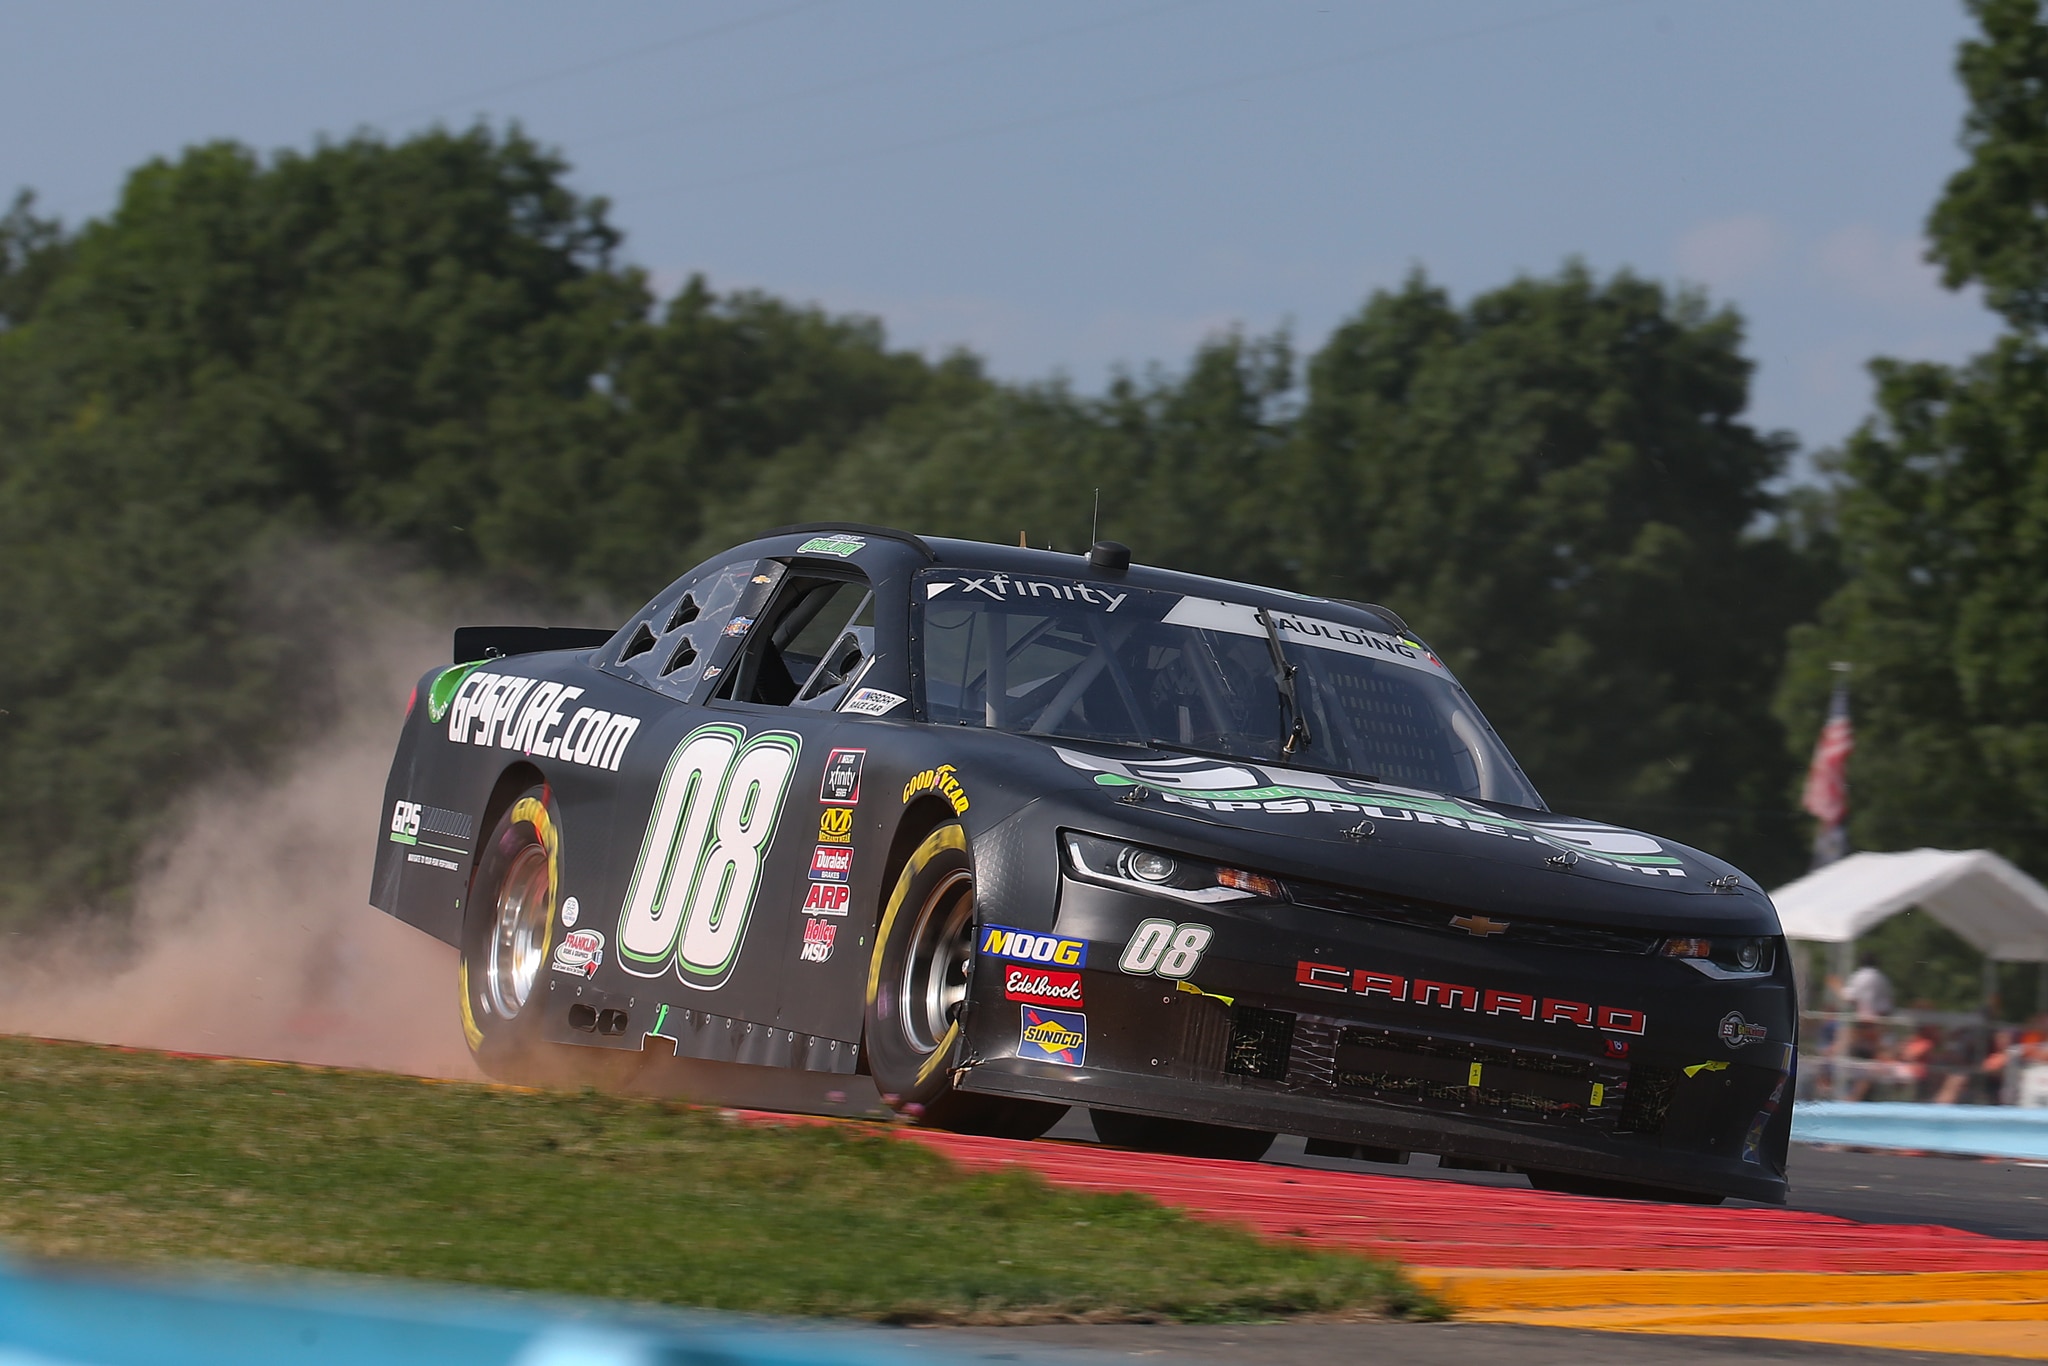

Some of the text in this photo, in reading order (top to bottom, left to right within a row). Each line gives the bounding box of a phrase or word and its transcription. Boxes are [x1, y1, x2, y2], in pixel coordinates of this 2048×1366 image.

[958, 574, 1127, 612] xfinity
[829, 765, 856, 792] xfinity
[903, 768, 970, 817] GOODYEAR
[391, 800, 421, 836] GPS
[618, 727, 798, 976] 08
[816, 850, 845, 870] Duralast
[805, 885, 849, 910] ARP
[566, 934, 598, 953] FRANKLIN
[800, 942, 829, 963] MSD
[982, 930, 1083, 966] MOOG
[1121, 921, 1213, 978] 08
[1006, 971, 1081, 1001] Edelbrock
[1295, 961, 1647, 1035] CAMARO
[1024, 1027, 1081, 1048] SUNOCO
